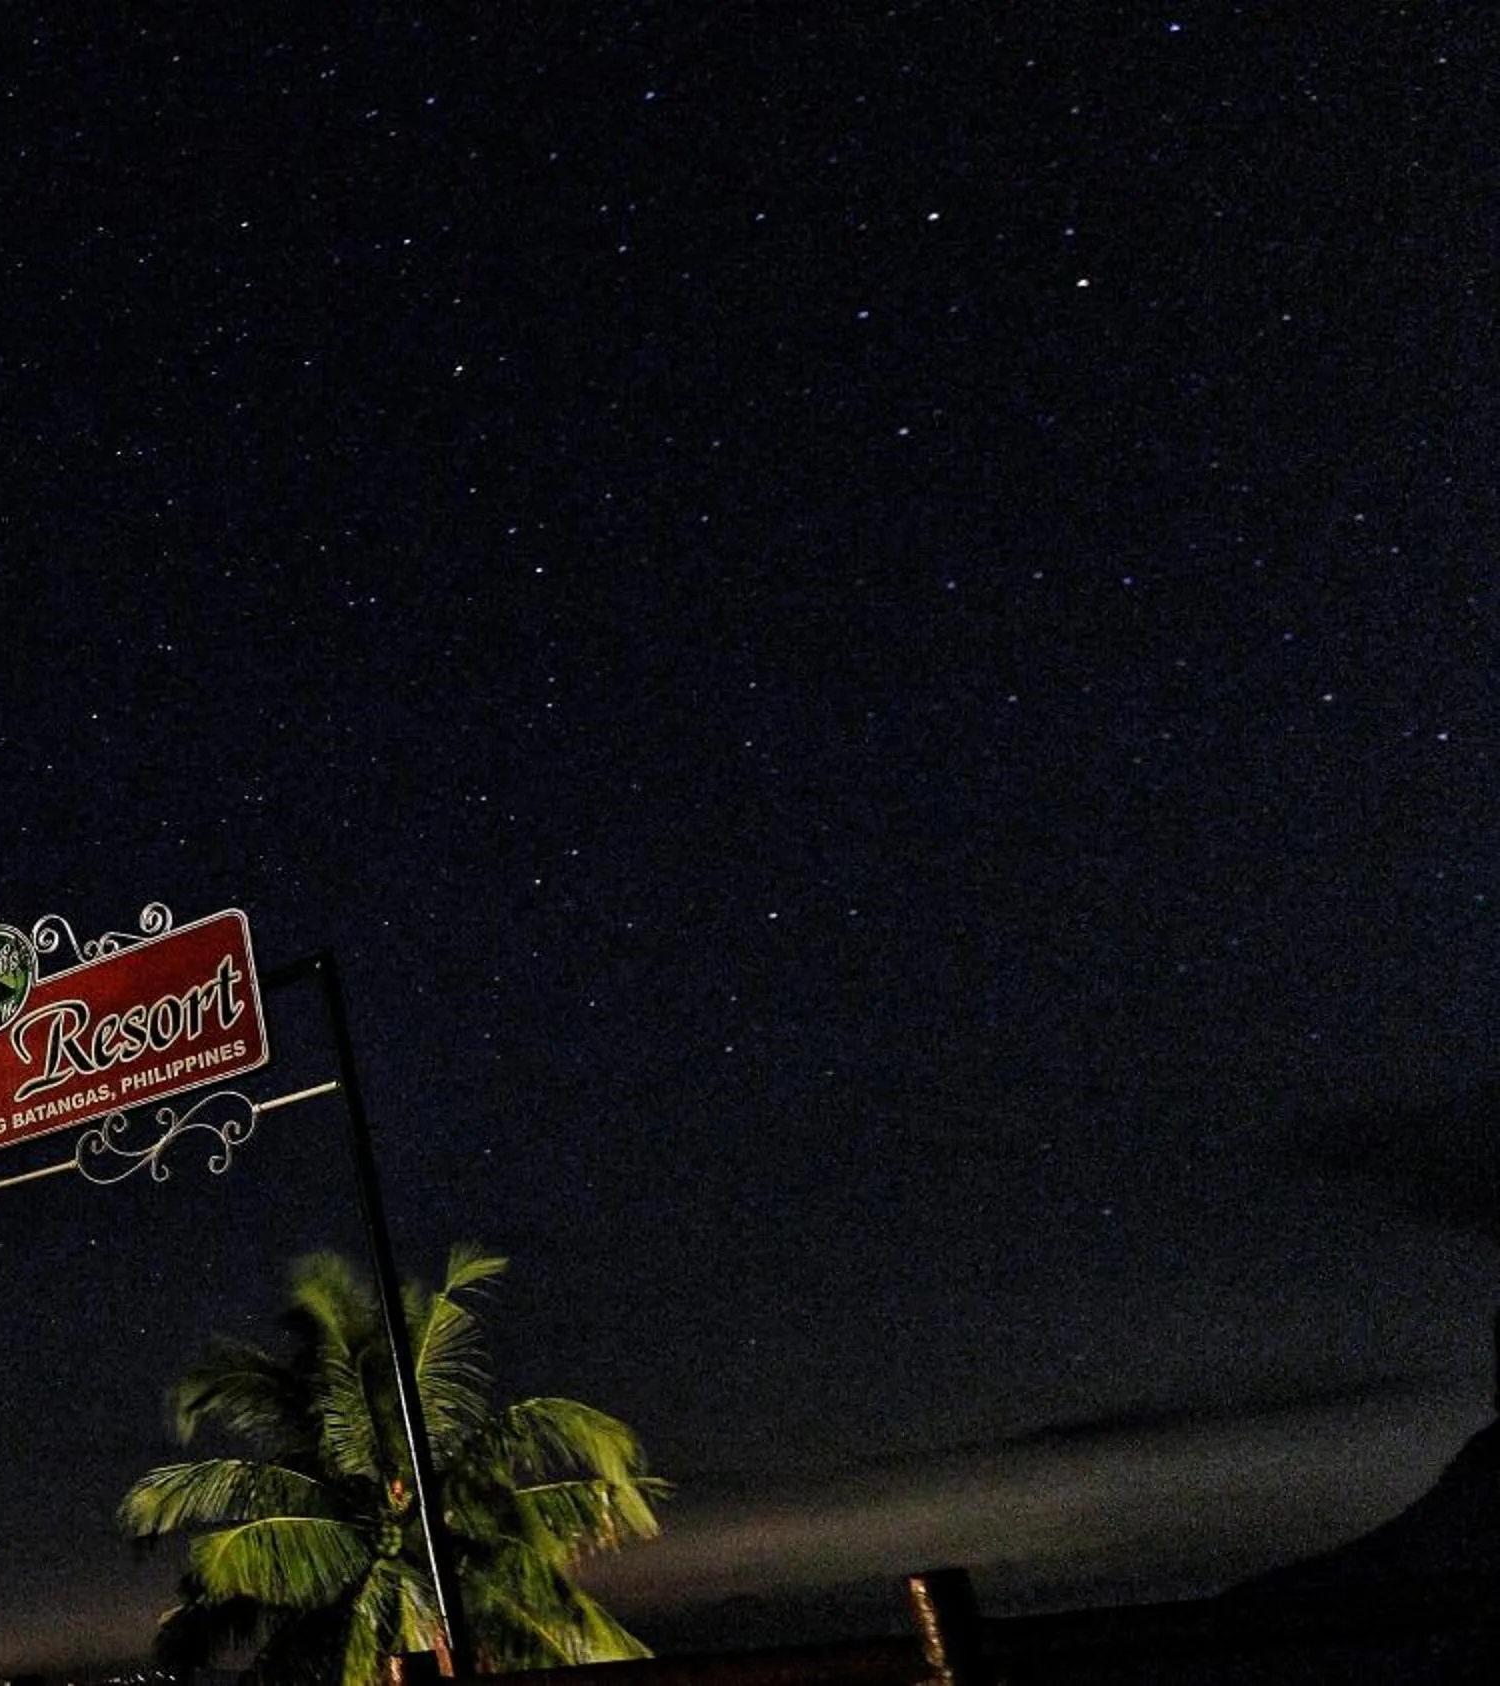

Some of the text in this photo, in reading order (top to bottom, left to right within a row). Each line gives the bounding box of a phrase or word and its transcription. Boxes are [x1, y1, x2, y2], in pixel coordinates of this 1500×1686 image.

[11, 954, 244, 1102] Resort
[12, 1083, 117, 1129] BATANGAS,
[121, 1040, 247, 1095] PHILIPPINES
